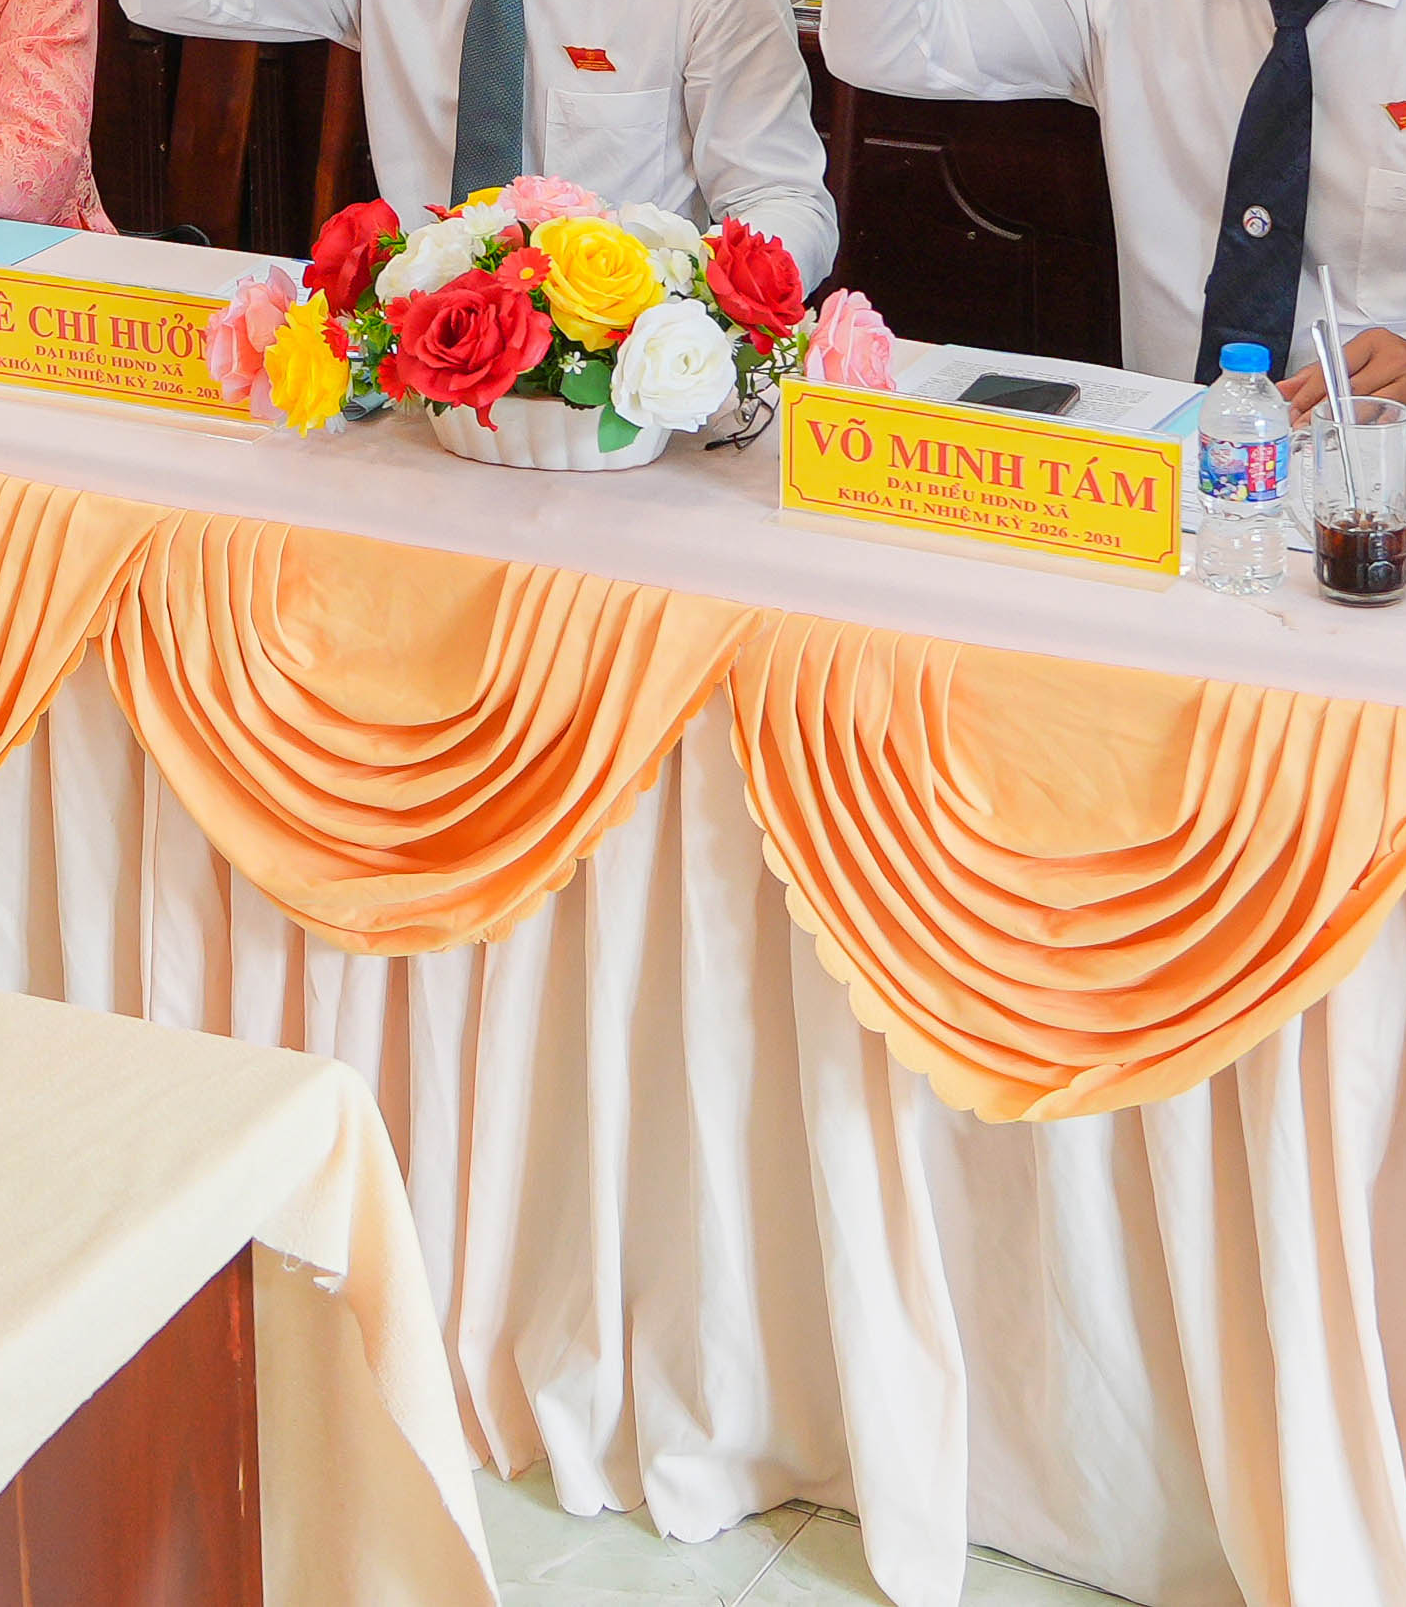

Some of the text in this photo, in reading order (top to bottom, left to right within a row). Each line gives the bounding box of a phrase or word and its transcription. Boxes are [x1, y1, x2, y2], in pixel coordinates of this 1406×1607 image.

[29, 304, 99, 345] CHÍ
[35, 345, 184, 377] ĐẠI BIỂU HĐND XÃ
[66, 367, 121, 384] NHIỆM
[125, 376, 147, 389] KỲ
[153, 380, 183, 395] 2026
[196, 387, 223, 400] 203
[806, 418, 1158, 512] VÕ MINH TÁM
[837, 487, 892, 507] KHÓA
[899, 498, 918, 513] II,
[923, 503, 992, 525] NHIỆM
[996, 515, 1023, 530] KỲ
[1030, 521, 1068, 539] 2026
[1084, 531, 1122, 548] 2031
[887, 477, 1069, 520] ĐẠI BIỂU HĐND XÃ
